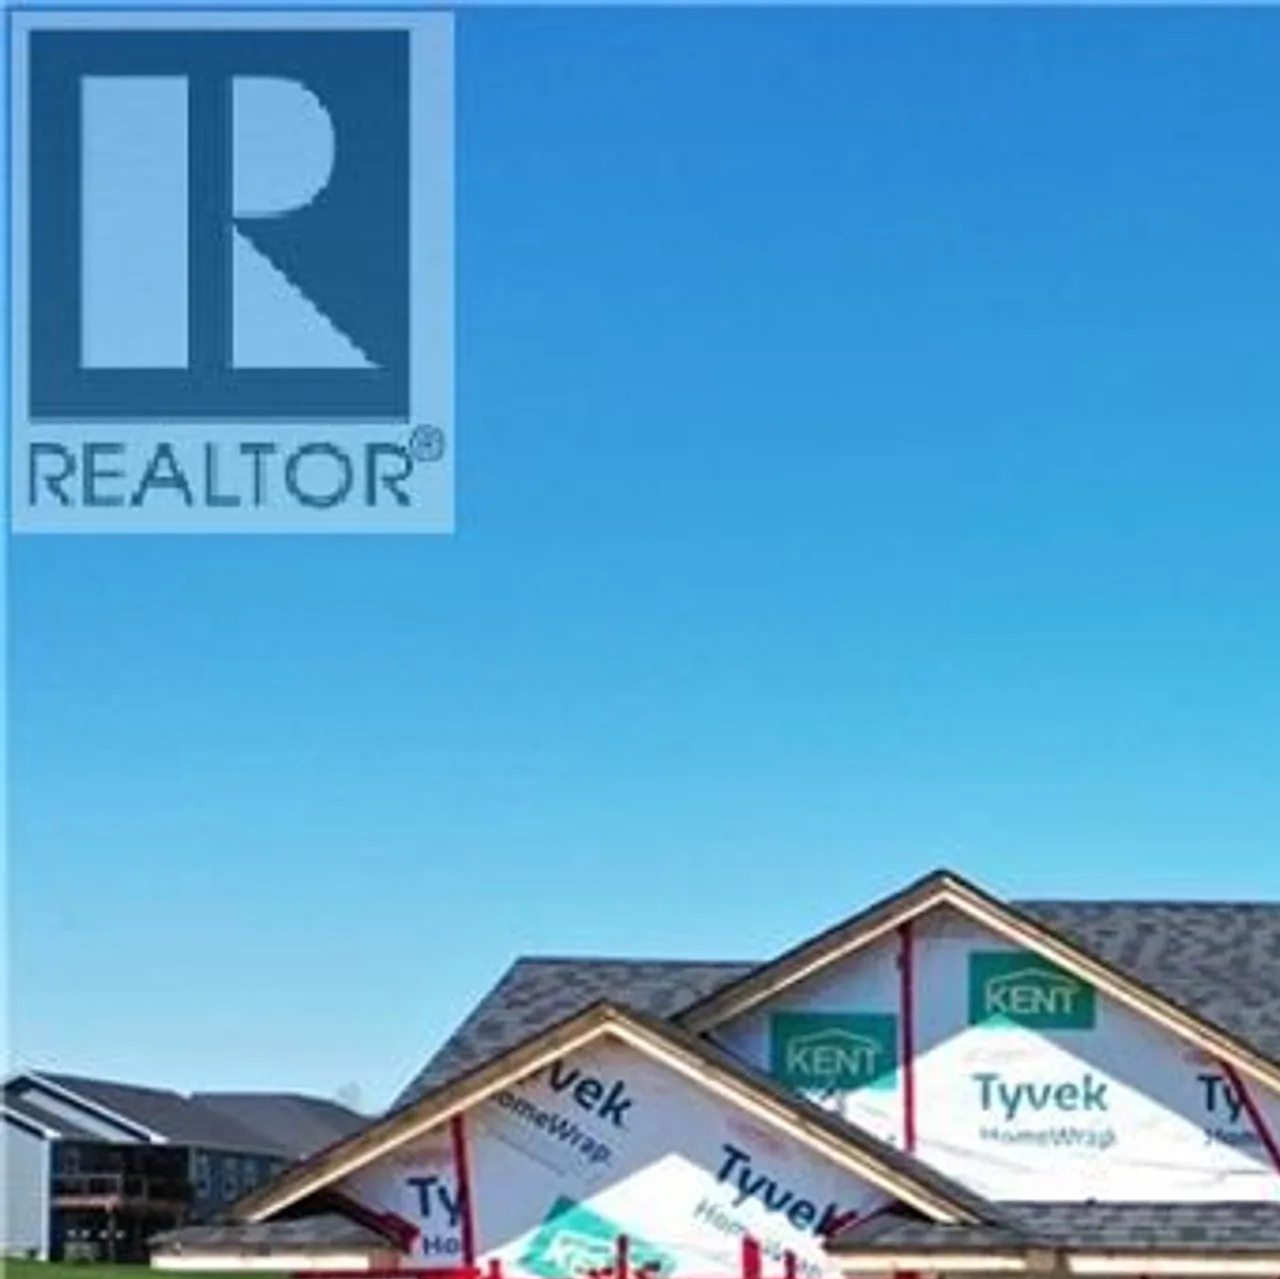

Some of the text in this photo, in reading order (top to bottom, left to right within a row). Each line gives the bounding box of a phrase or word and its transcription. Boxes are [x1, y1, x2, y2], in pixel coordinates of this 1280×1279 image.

[984, 982, 1076, 1015] KENT
[787, 1045, 876, 1076] KENT
[552, 1060, 632, 1127] vek
[972, 1073, 1108, 1121] Tyvek
[1197, 1076, 1243, 1122] Ty
[497, 1090, 613, 1166] omeWrap
[405, 1176, 461, 1228] Ty
